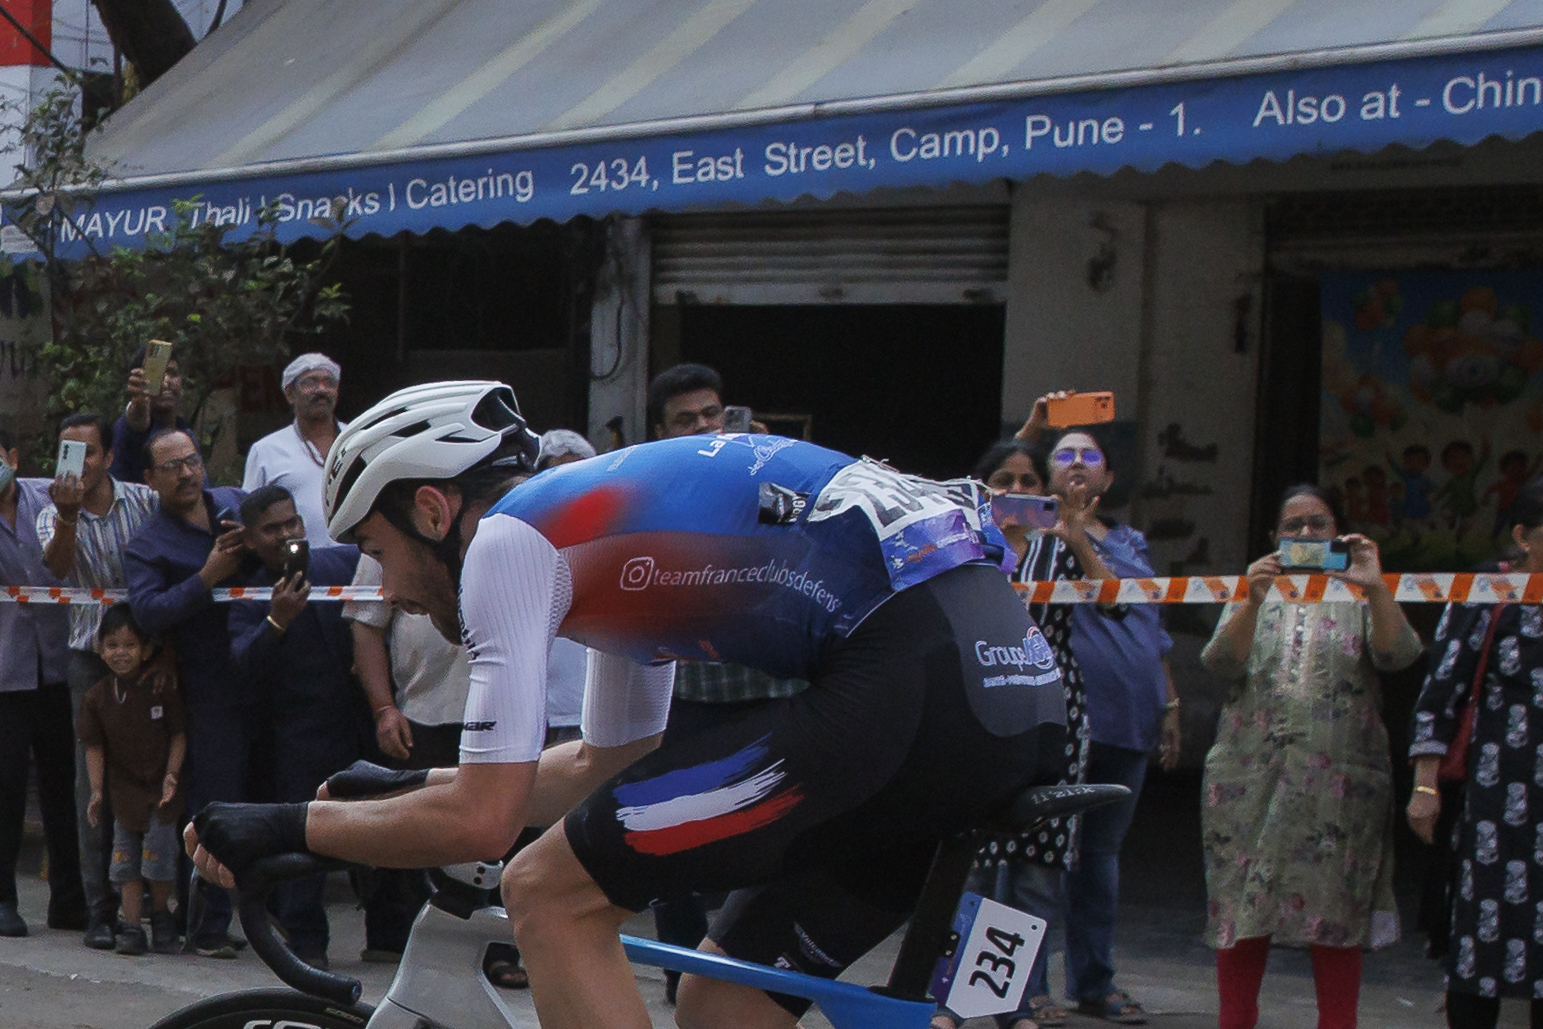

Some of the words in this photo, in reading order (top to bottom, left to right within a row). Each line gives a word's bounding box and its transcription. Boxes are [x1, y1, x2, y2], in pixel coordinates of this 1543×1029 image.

[60, 205, 169, 244] MAYUR
[275, 186, 381, 223] Snaks
[405, 168, 536, 212] Catering
[570, 156, 659, 196] 2434,
[672, 147, 746, 186] East
[764, 134, 877, 178] Street,
[890, 127, 1011, 164] Camp,
[1025, 114, 1125, 150] Pune
[1169, 102, 1203, 138] 1.
[1253, 89, 1347, 129] Also
[1360, 83, 1401, 121] at
[968, 926, 1026, 999] 234
